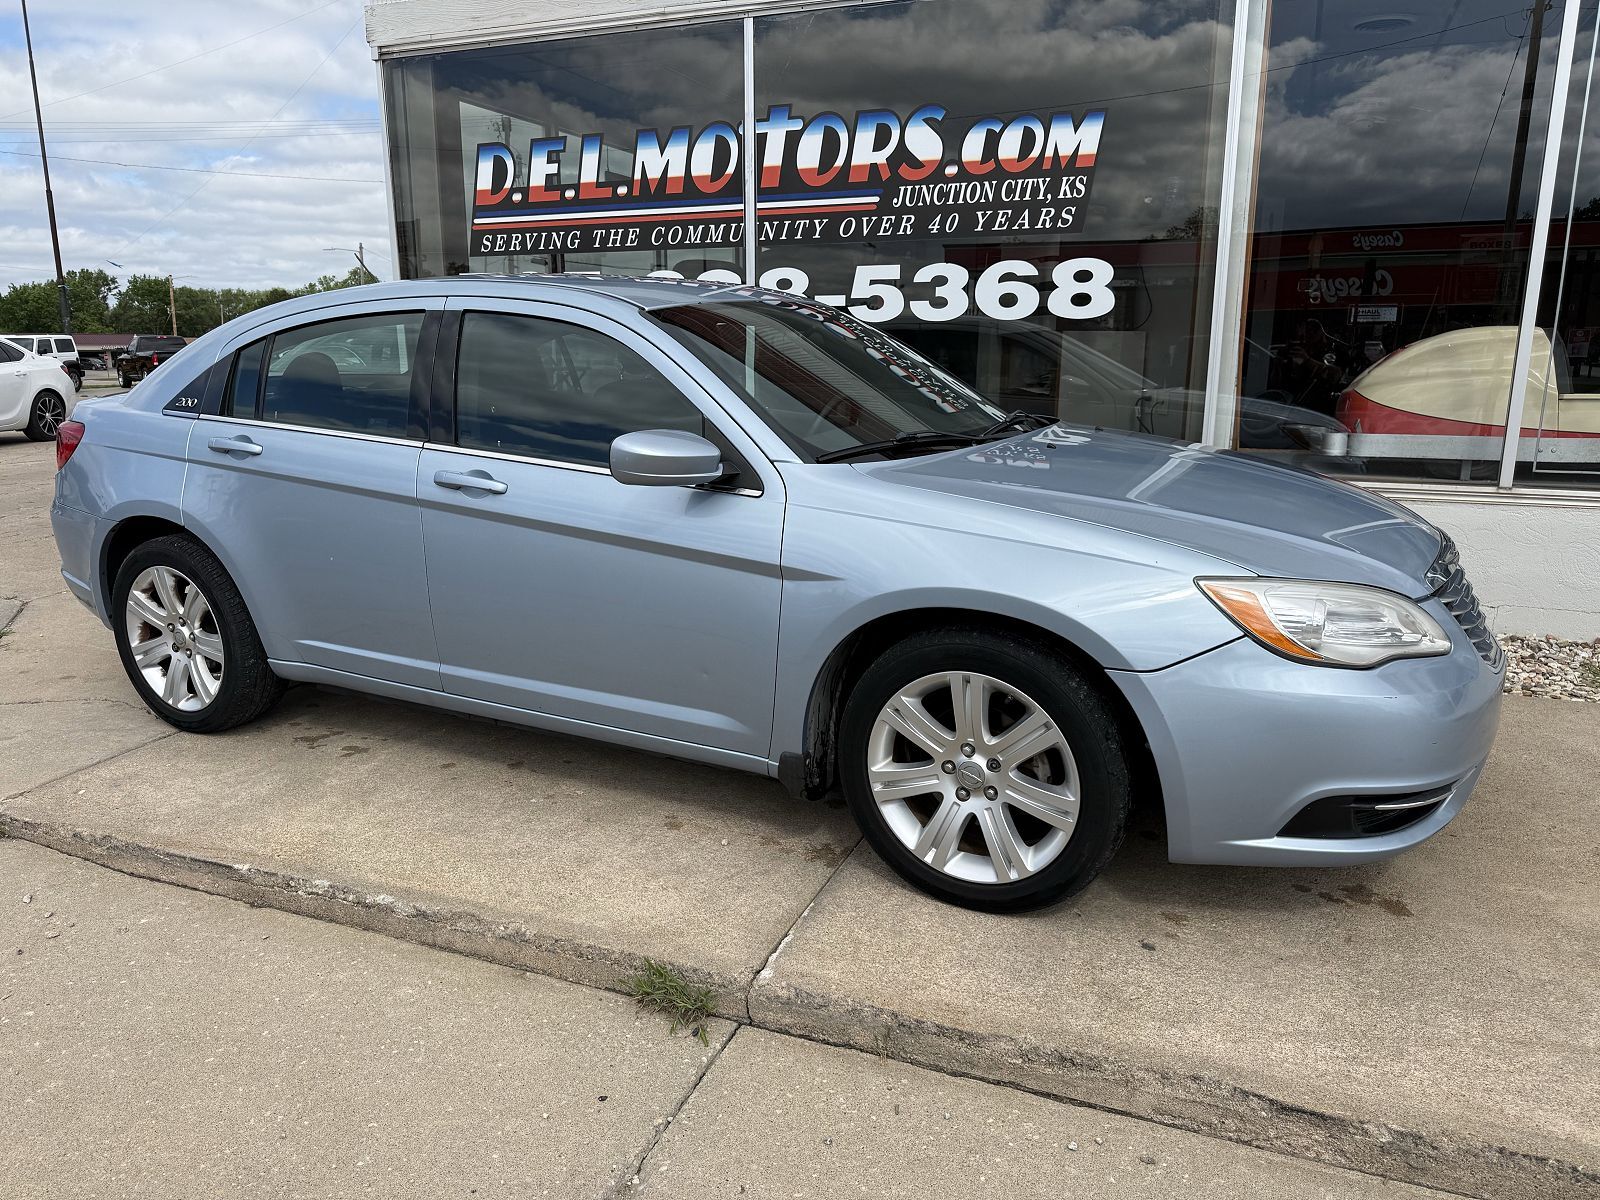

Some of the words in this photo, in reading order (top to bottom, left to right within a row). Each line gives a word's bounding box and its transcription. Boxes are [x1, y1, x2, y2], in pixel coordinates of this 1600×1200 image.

[892, 180, 998, 208] JUNCTION
[1001, 177, 1054, 204] CITY,
[1058, 175, 1088, 198] KS
[480, 229, 581, 252] SERVING
[592, 227, 640, 247] THE
[651, 218, 829, 246] COMMUNITY
[839, 214, 915, 239] OVER
[928, 212, 960, 234] 40
[973, 205, 1077, 232] YEARS
[176, 397, 197, 407] 200
